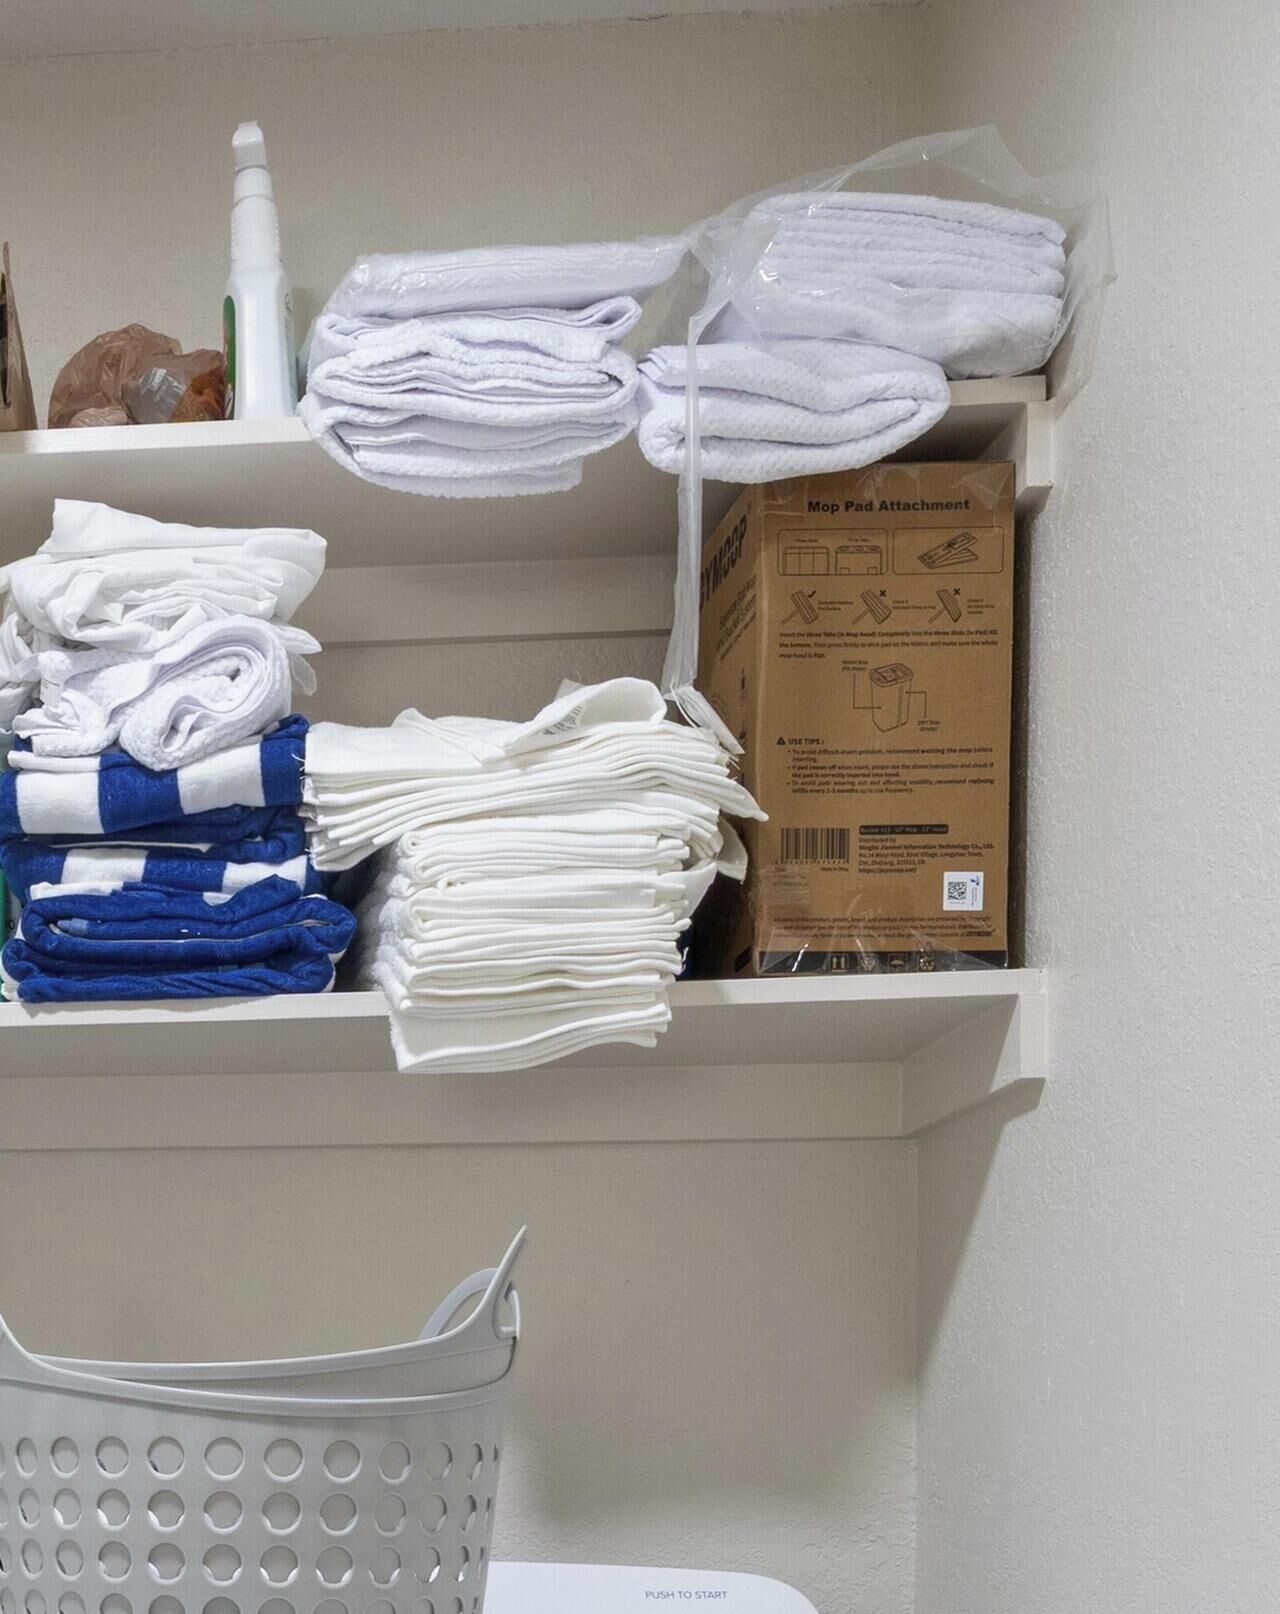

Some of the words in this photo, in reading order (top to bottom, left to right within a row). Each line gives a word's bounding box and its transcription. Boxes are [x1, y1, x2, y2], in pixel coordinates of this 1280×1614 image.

[807, 501, 840, 515] Mop
[844, 501, 873, 512] Pad
[878, 500, 970, 512] Attachment
[645, 1591, 674, 1599] PUSH
[678, 1591, 692, 1599] TO
[695, 1591, 728, 1599] START
